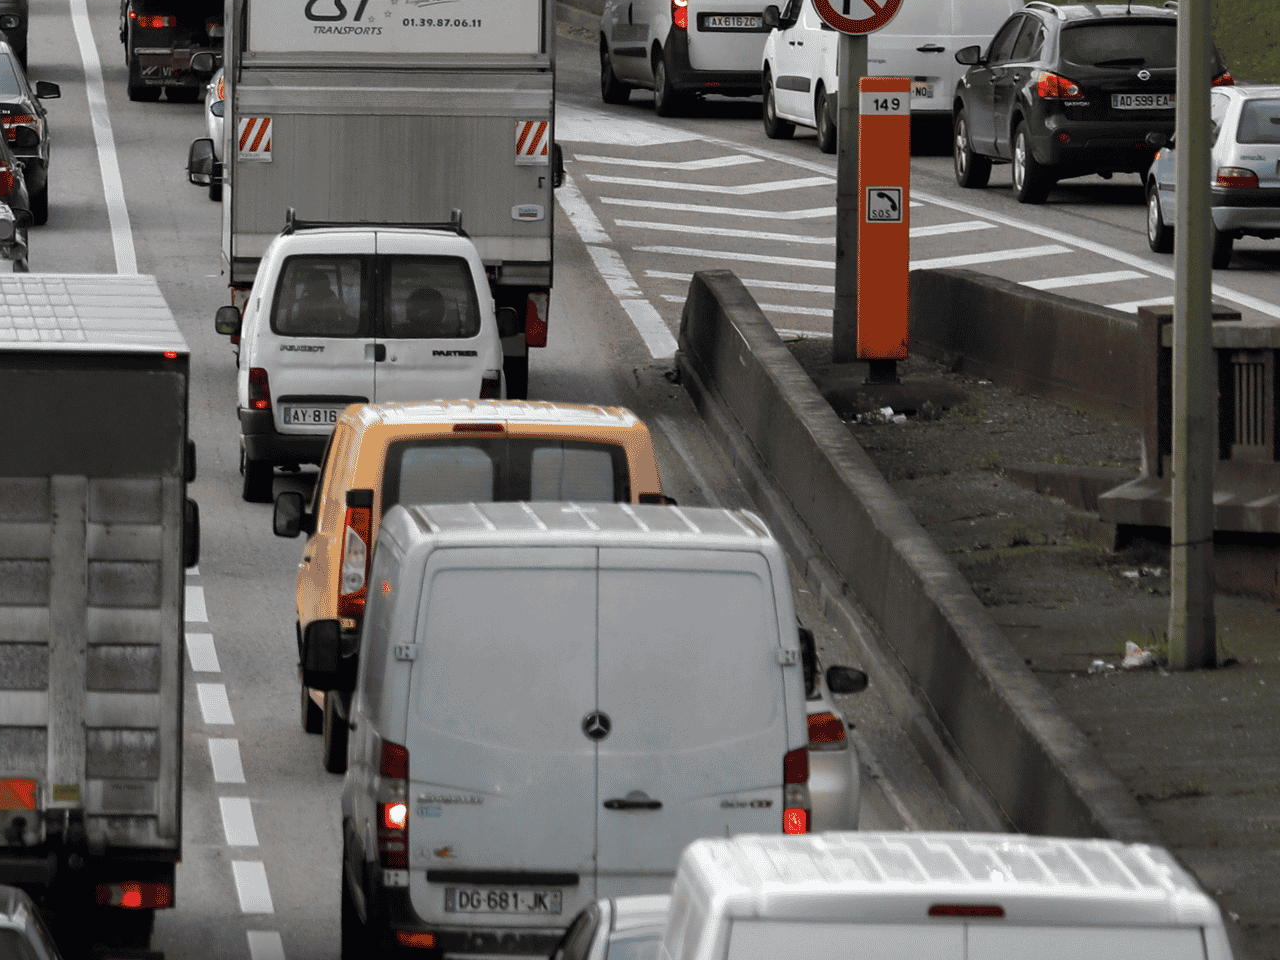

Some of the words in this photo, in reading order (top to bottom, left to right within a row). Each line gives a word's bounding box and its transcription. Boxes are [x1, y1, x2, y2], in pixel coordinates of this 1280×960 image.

[402, 18, 482, 28] 01.39.87.06.11
[313, 25, 383, 35] TRANSPORTS
[873, 98, 901, 112] 149
[459, 890, 548, 911] DG-681-JK
